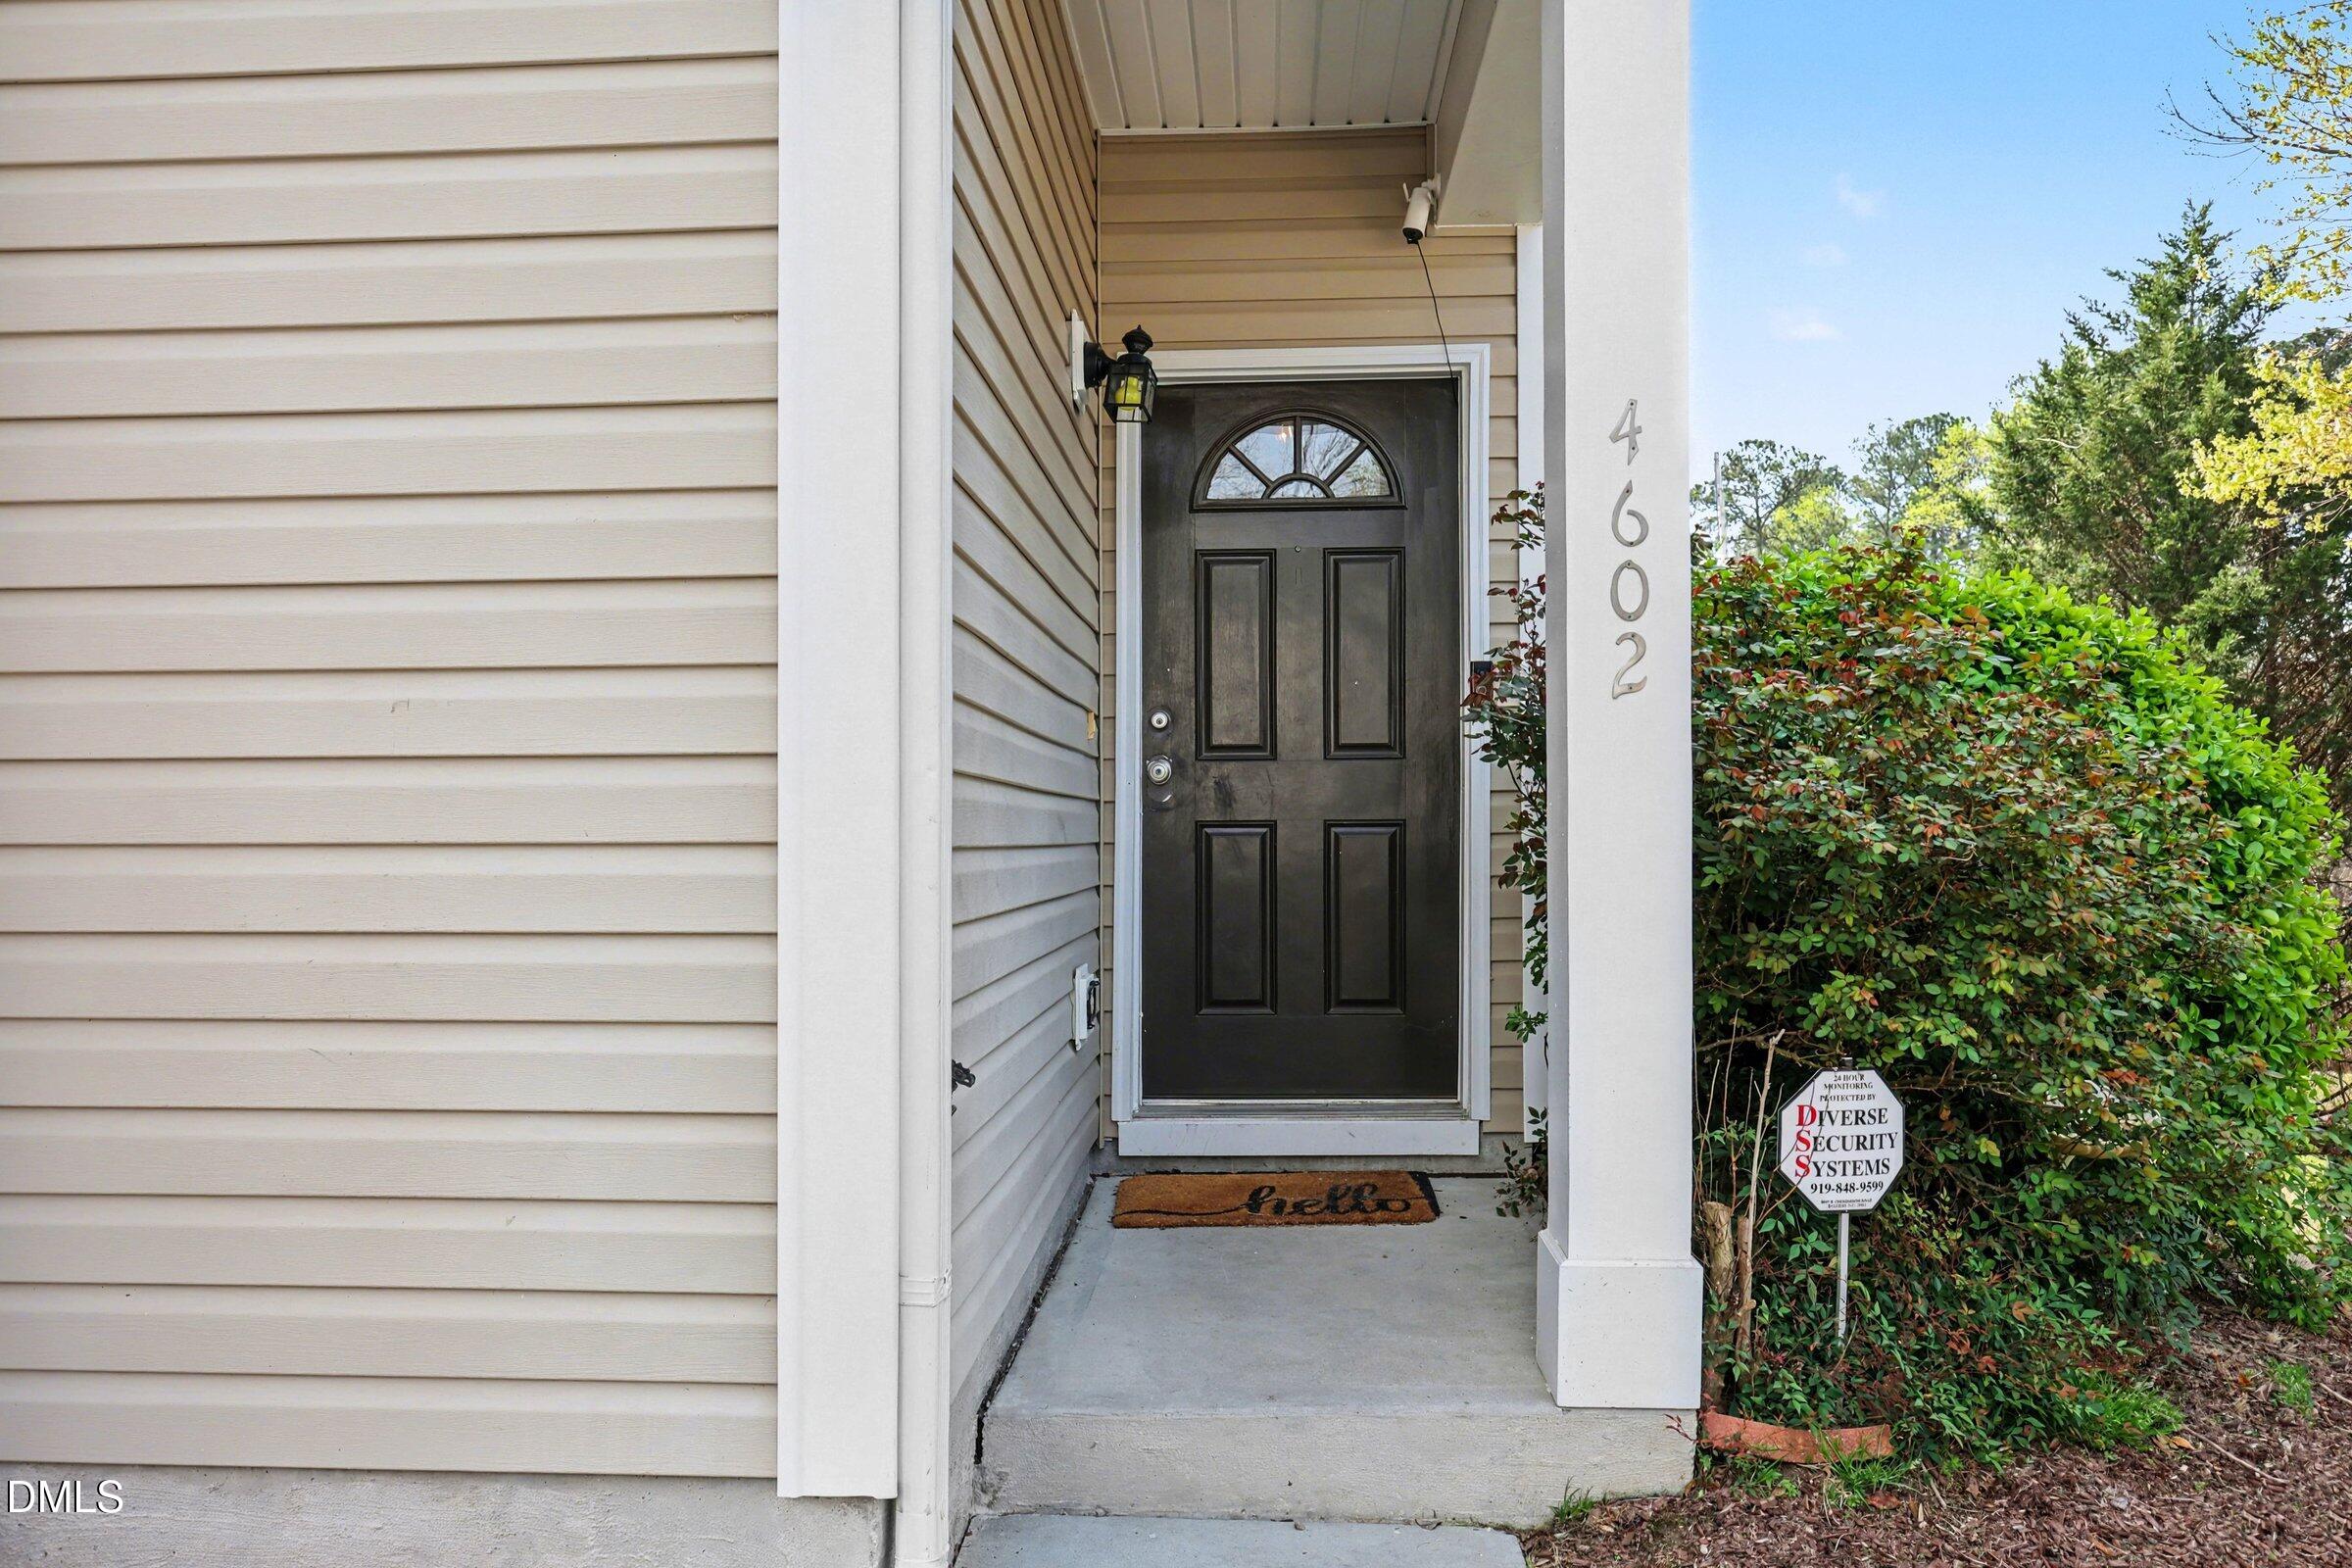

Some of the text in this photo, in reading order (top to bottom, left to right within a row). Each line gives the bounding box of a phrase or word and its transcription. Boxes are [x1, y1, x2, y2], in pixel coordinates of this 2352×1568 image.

[1609, 399, 1649, 699] 4602
[1795, 1104, 1888, 1127] DIVERSE
[1795, 1129, 1898, 1152] SECURITY
[1795, 1154, 1890, 1178] SYSTEMS
[1246, 1183, 1411, 1216] hello
[1810, 1181, 1884, 1195] 919-848-9599
